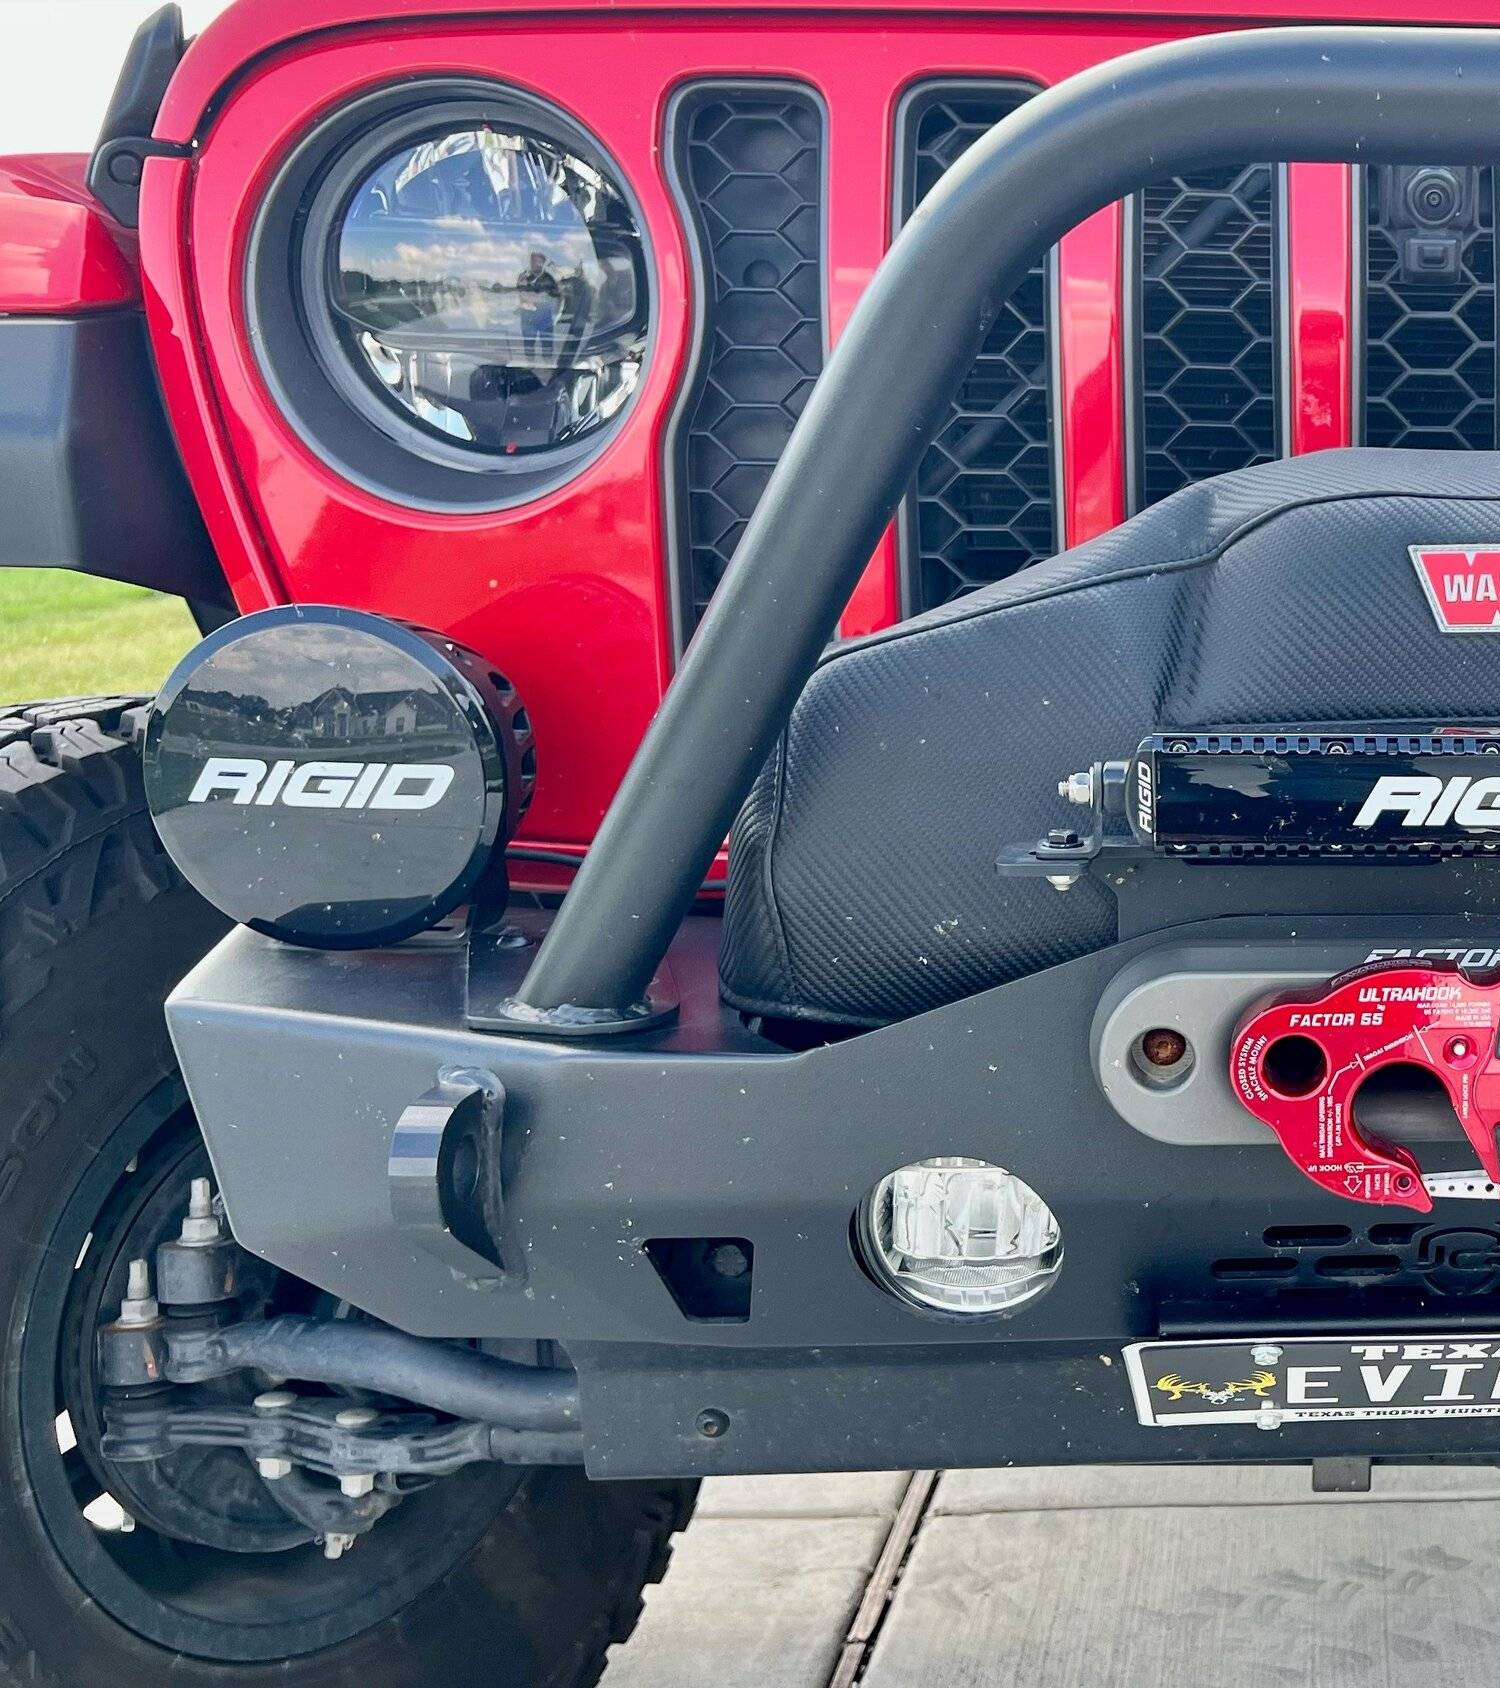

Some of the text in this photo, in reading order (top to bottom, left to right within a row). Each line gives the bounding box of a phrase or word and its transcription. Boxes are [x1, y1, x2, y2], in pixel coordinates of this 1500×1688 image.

[188, 757, 455, 810] RIGID
[1137, 761, 1153, 834] RIGID
[1358, 985, 1464, 1003] ULTRAHOOK
[1289, 1012, 1383, 1028] FACTOR 55
[1237, 1037, 1255, 1100] CLOSED SYSTEM
[1247, 1034, 1269, 1101] SHACKLE MOUNT
[1319, 1164, 1343, 1172] HOOK
[1295, 1410, 1355, 1418] TEXAS
